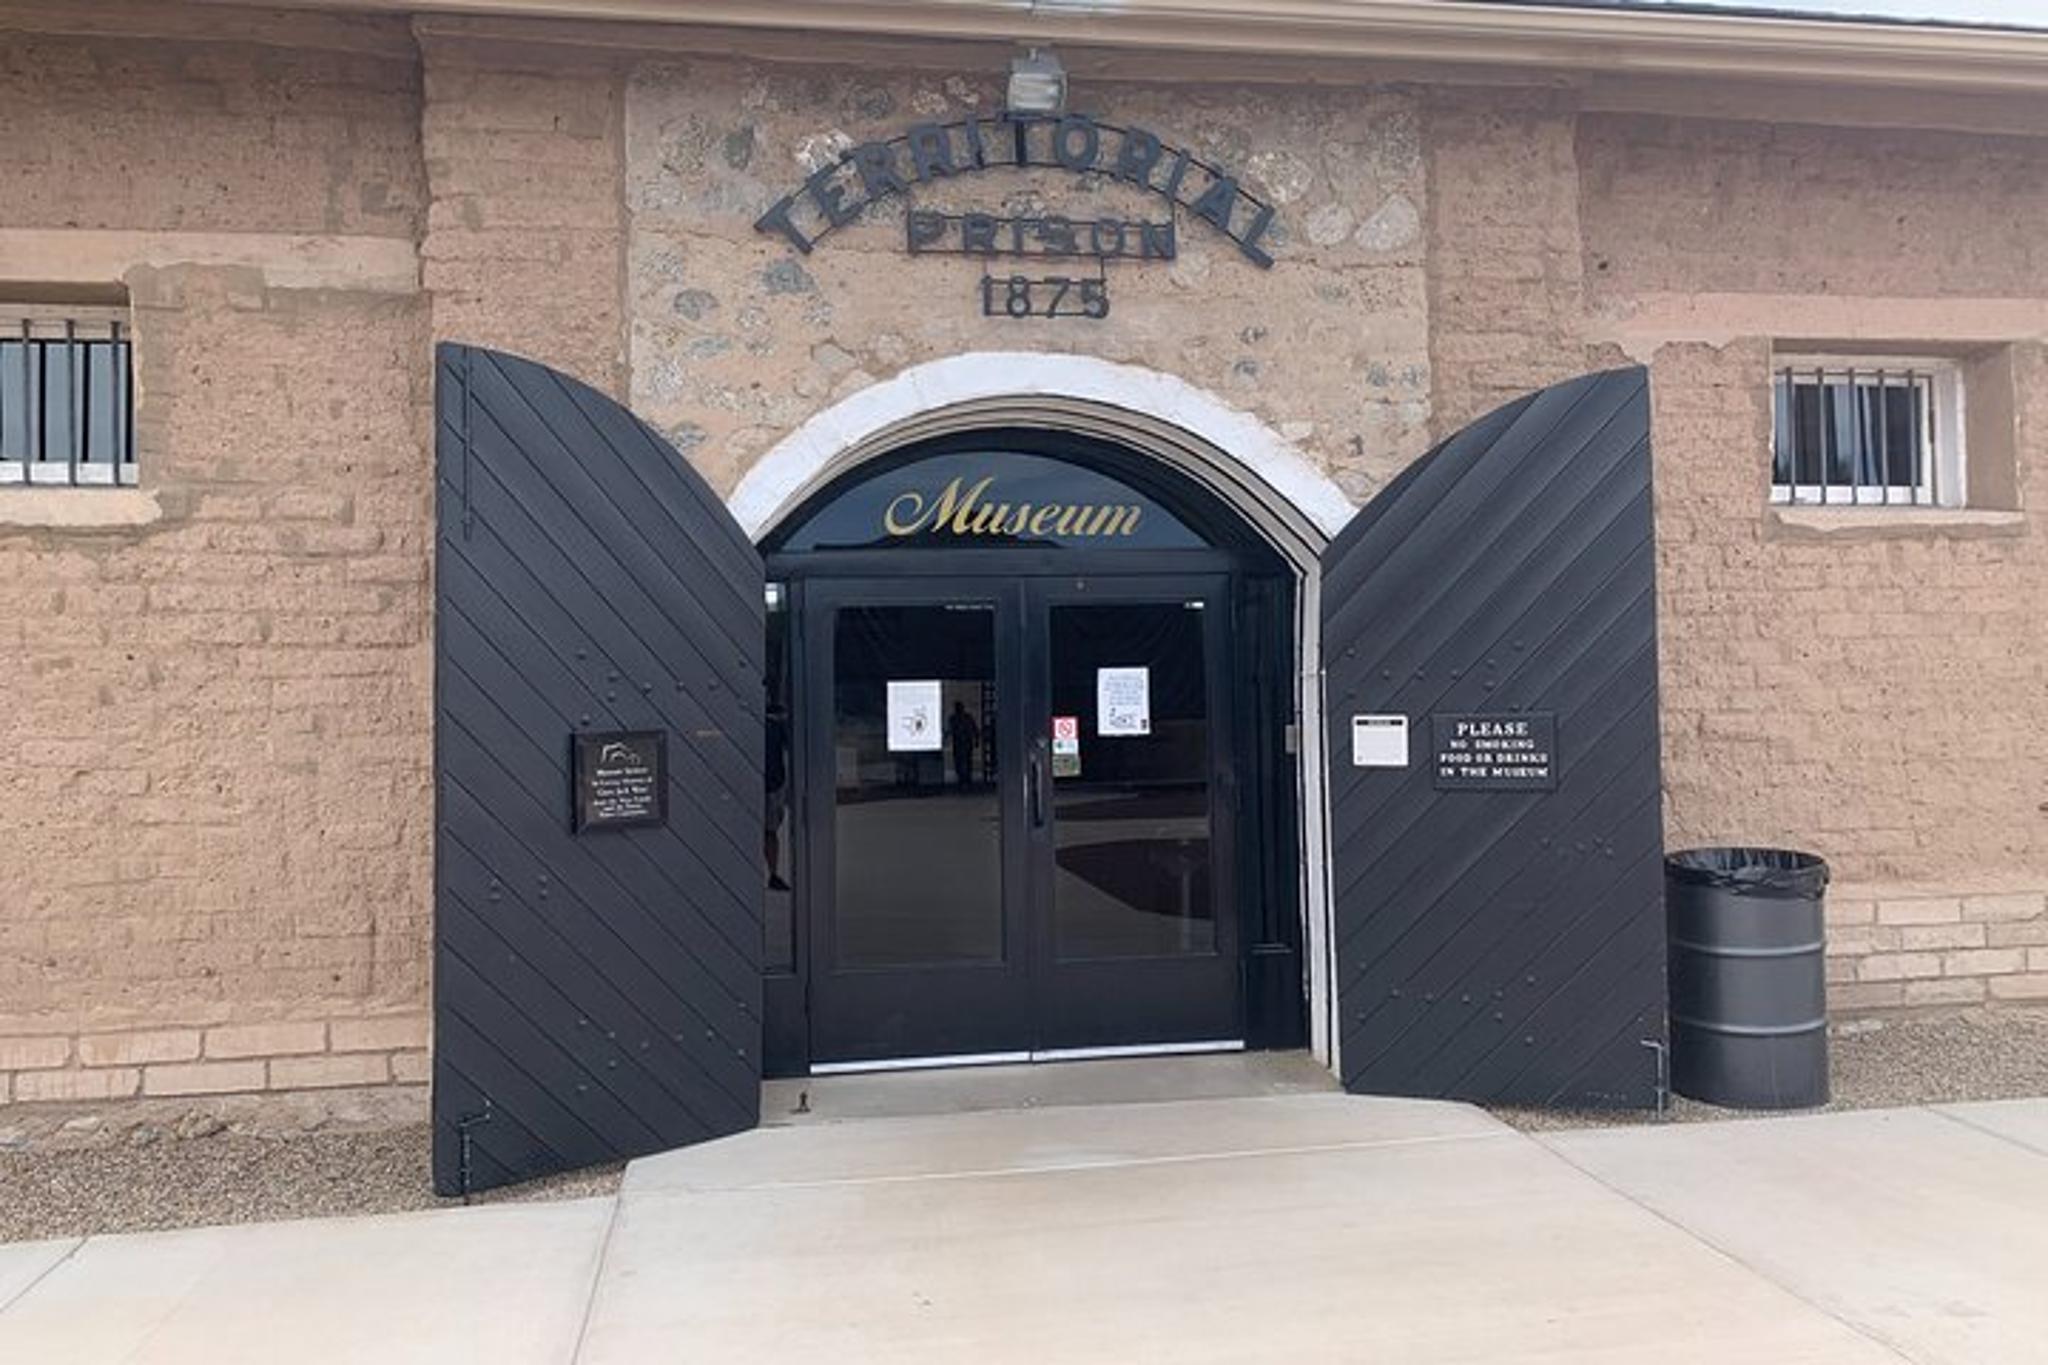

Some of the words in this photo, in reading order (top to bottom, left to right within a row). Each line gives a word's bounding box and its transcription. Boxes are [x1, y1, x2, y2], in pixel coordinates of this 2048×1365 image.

[754, 111, 1275, 269] TERRITORIAL
[909, 212, 1174, 258] PRISON
[982, 275, 1110, 319] 1875
[884, 476, 1142, 537] Museum
[1449, 739, 1469, 749] NO
[1475, 739, 1535, 749] SMOKING
[1457, 721, 1529, 737] PLEASE
[1439, 753, 1472, 763] FOOD
[1475, 753, 1494, 763] OR
[1496, 753, 1548, 763] DRINKS
[1439, 767, 1455, 778] IN
[1461, 767, 1487, 778] THE
[1493, 767, 1548, 778] MUSEUM
